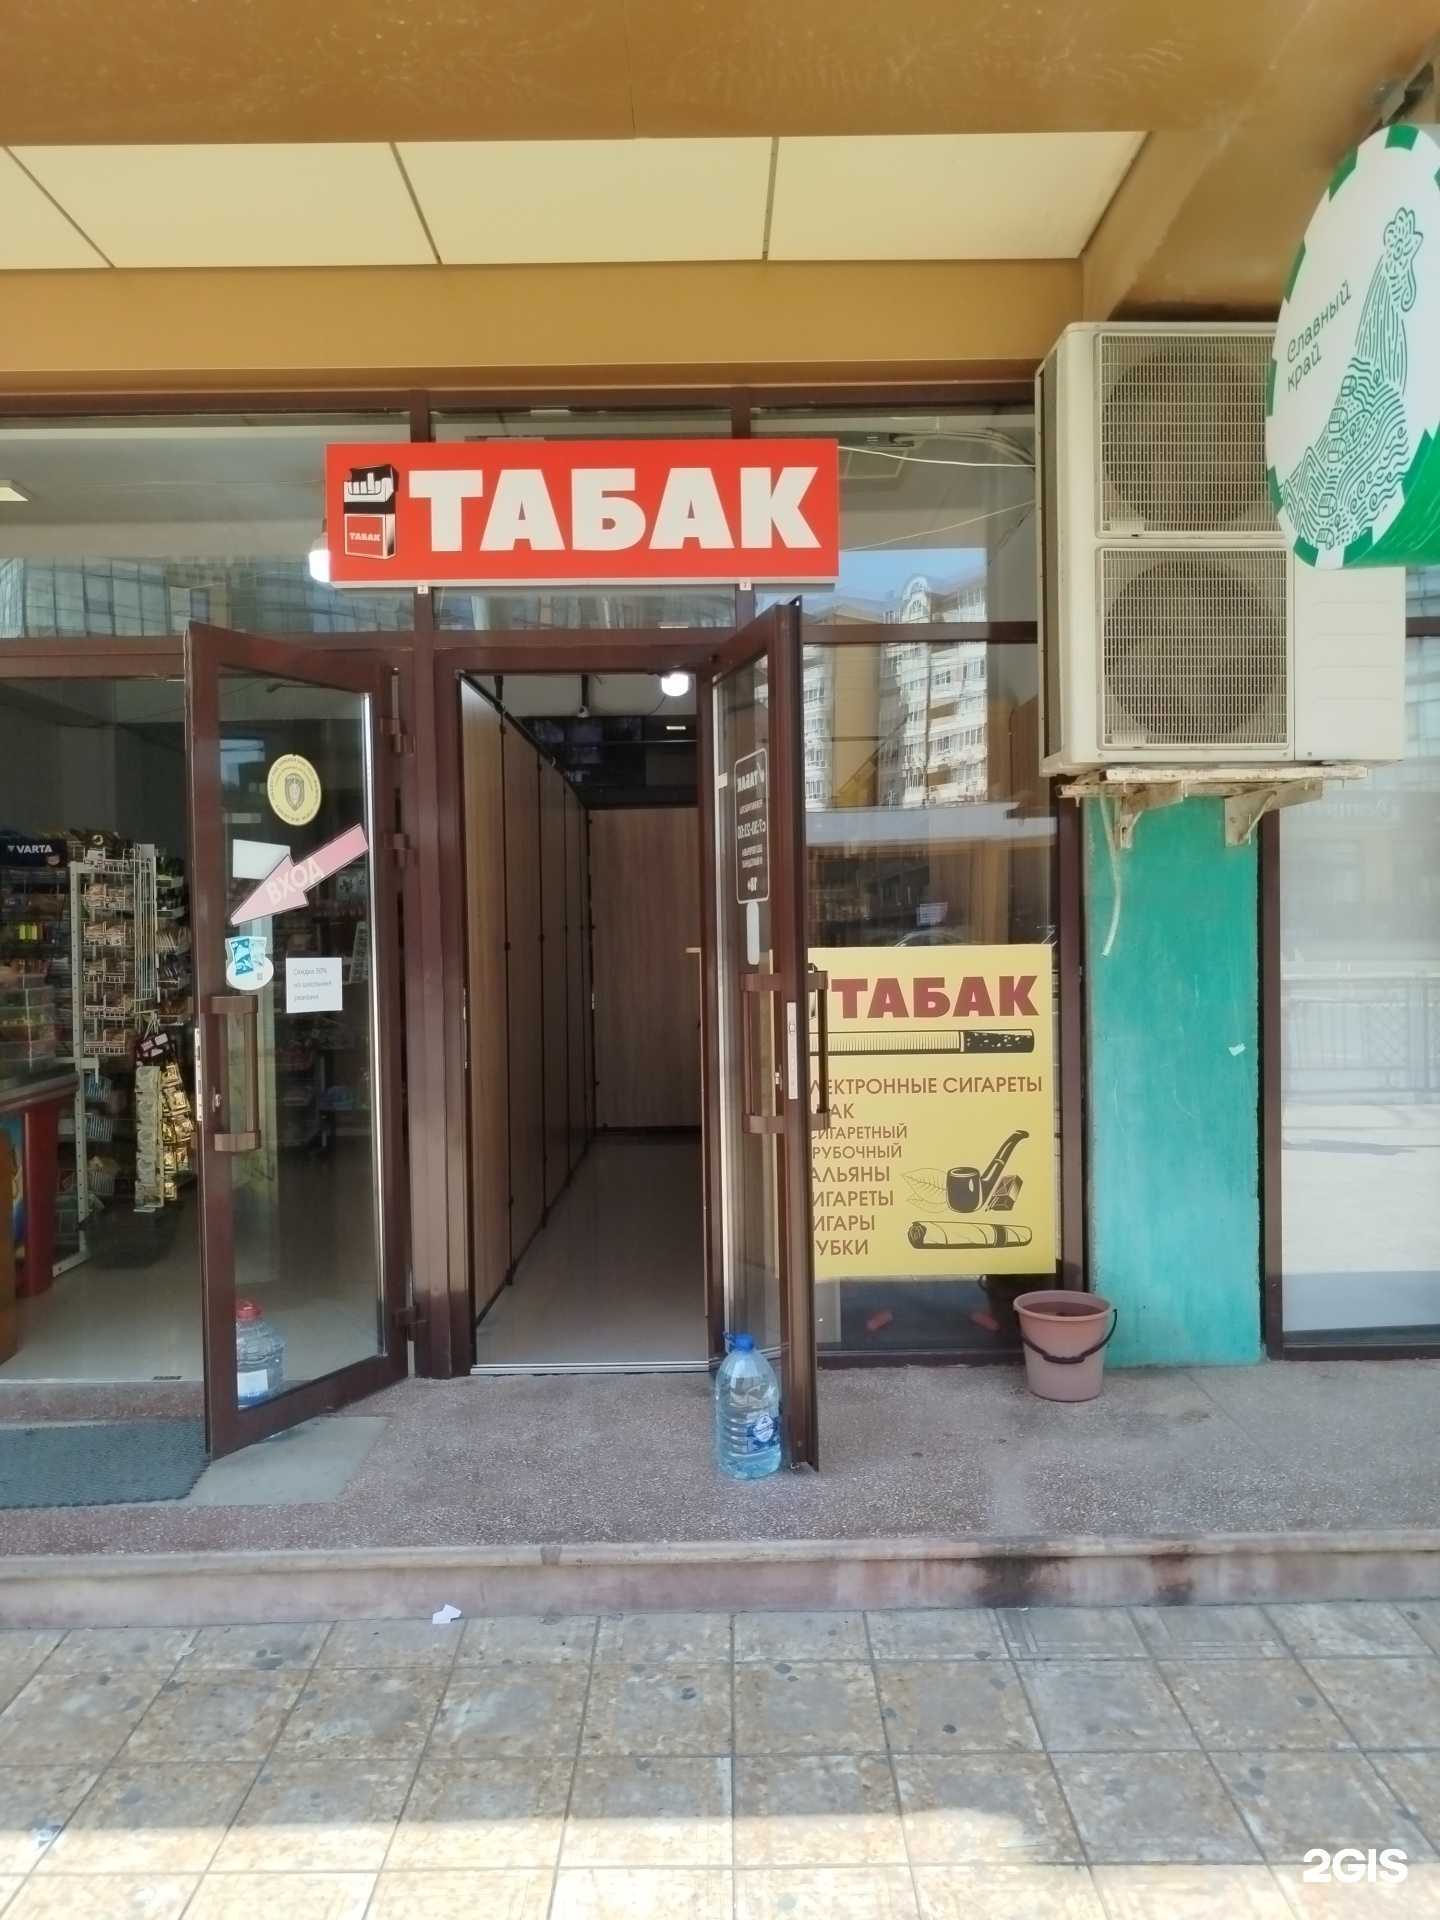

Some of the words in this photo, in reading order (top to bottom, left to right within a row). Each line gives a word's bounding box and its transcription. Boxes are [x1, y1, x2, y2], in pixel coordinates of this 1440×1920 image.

[1287, 342, 1322, 393] край
[408, 466, 821, 552] ТАБАК
[349, 532, 381, 542] ТАБАК
[16, 844, 53, 854] VARTA
[264, 856, 325, 906] ВХОД
[830, 975, 1040, 1019] ТАБАК
[810, 1077, 937, 1095] ЛЕКТРОННЫЕ
[943, 1076, 1042, 1093] СИГАРЕТЫ
[812, 1142, 902, 1159] РУБОЧНЫЙ
[810, 1165, 890, 1183] АЛЬЯНЫ
[811, 1190, 894, 1208] ИГАРЕТЫ
[813, 1214, 875, 1232] ИГАРЫ
[815, 1239, 869, 1256] УБКИ
